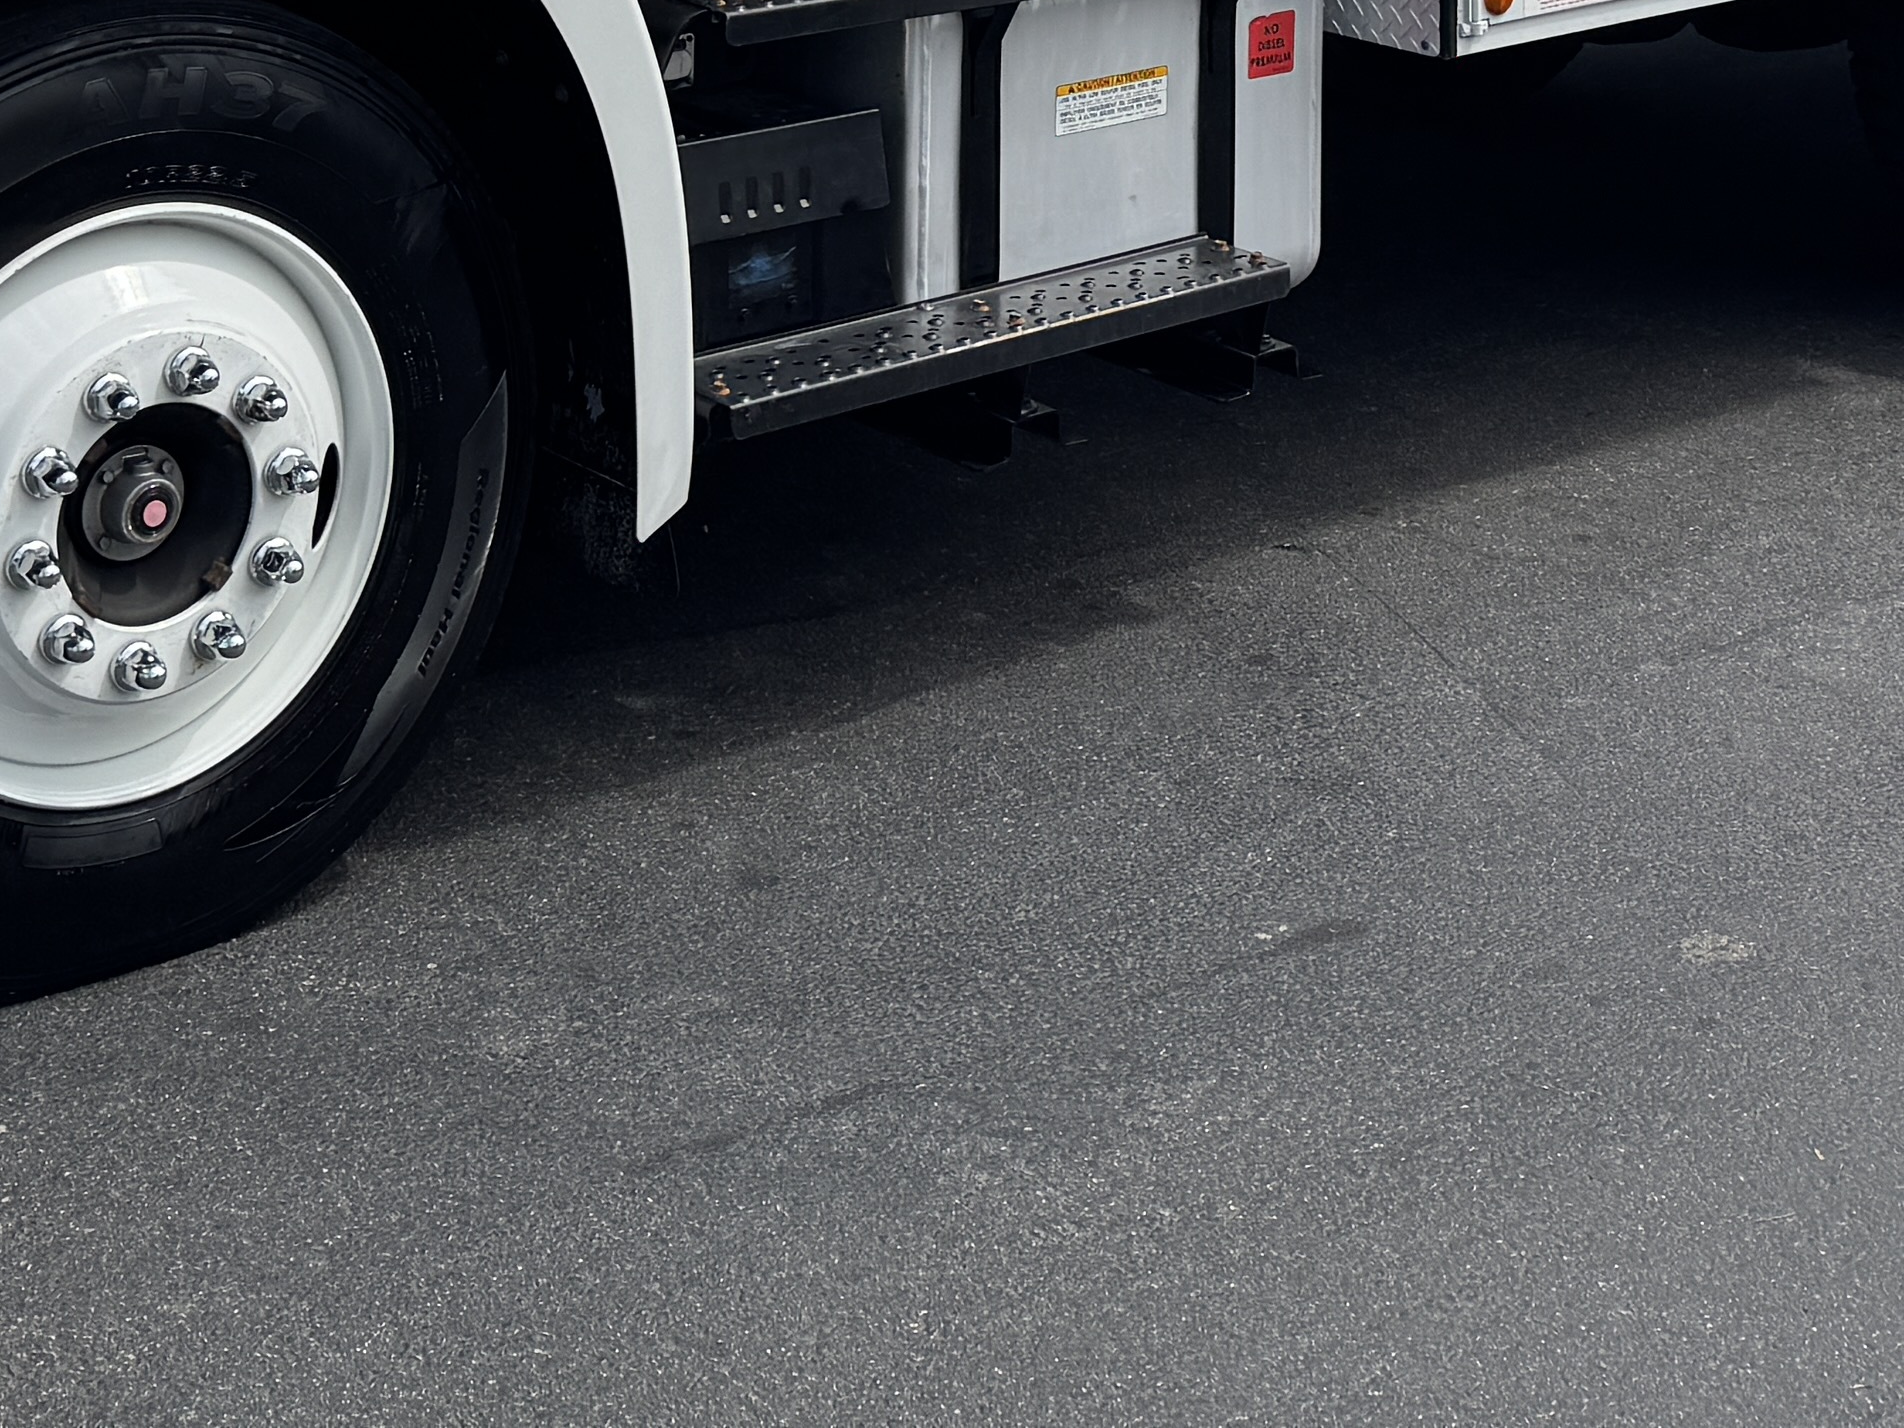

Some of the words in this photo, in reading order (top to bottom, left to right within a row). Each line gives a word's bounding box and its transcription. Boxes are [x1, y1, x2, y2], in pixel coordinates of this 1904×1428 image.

[79, 65, 328, 133] AH37
[450, 466, 490, 607] Regional
[419, 604, 454, 677] Haul
